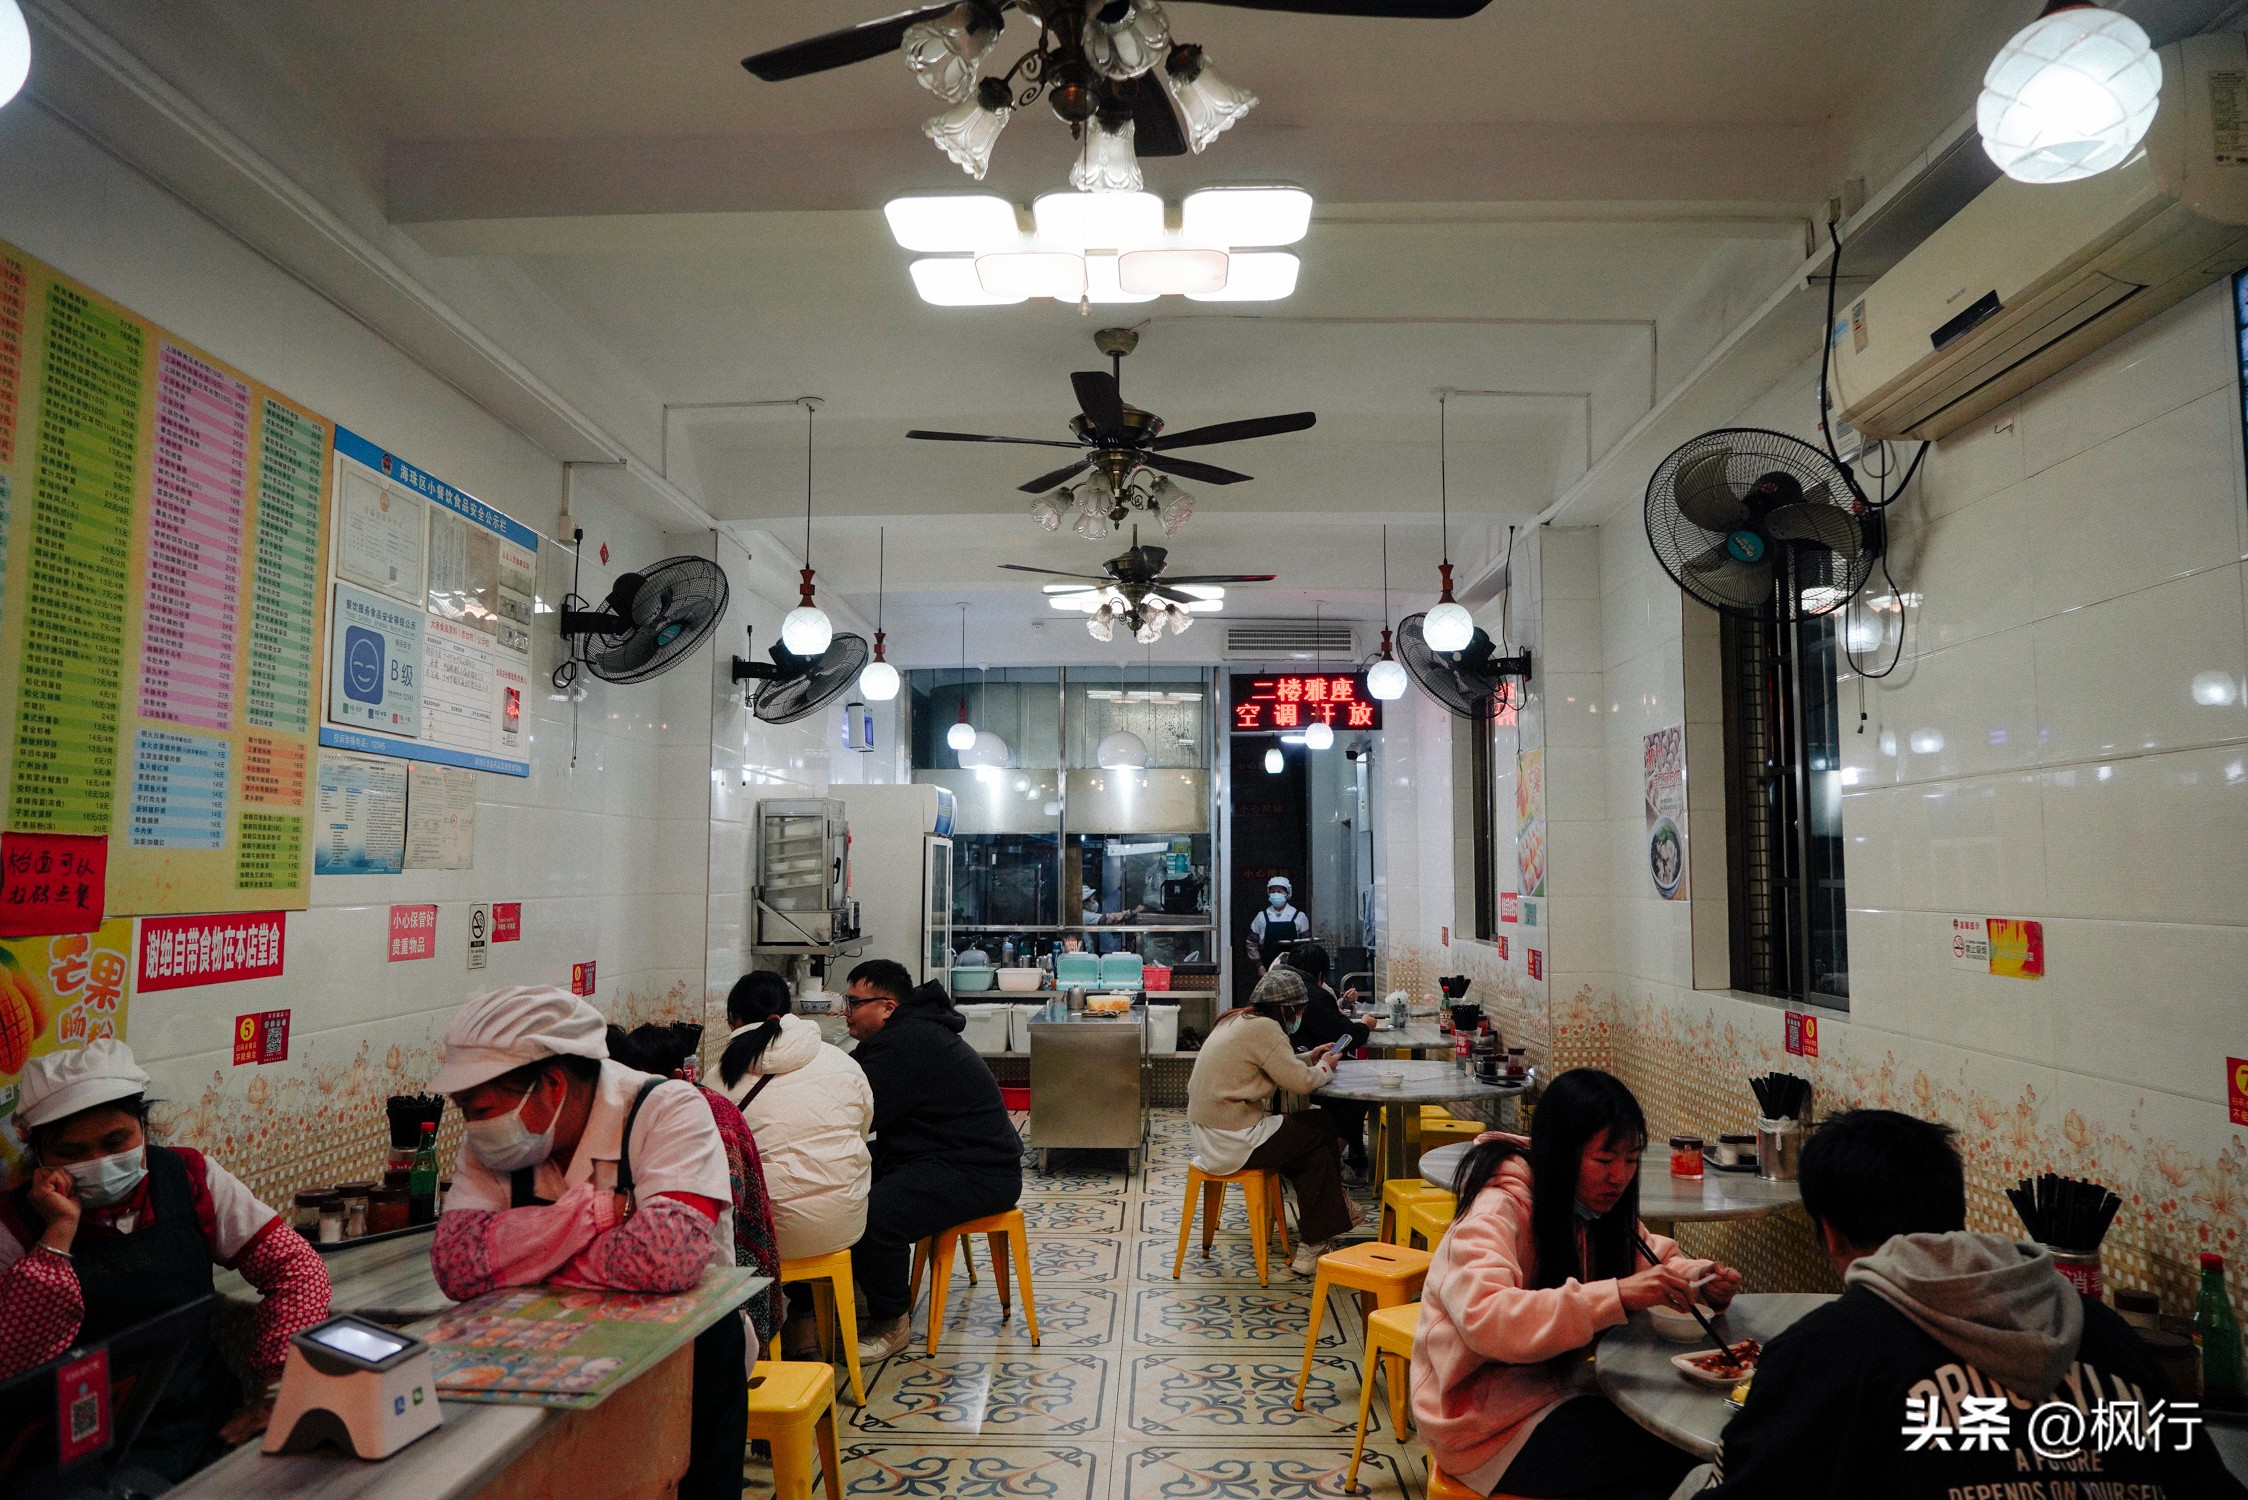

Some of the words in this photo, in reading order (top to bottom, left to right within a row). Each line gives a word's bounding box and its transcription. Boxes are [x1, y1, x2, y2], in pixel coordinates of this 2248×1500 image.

[120, 429, 133, 440] 20元
[400, 464, 507, 533] 海珠区小餐饮食品安全公示栏
[115, 515, 128, 526] 19元
[114, 526, 127, 536] 11元
[114, 537, 126, 547] 13元
[102, 544, 126, 558] 14元/2只
[100, 555, 125, 569] 20元/2只
[100, 577, 123, 590] 13元/4件
[97, 610, 121, 623] 13元/4件
[346, 599, 416, 630] 餐饮服务食品安全等级公示
[100, 622, 120, 634] 7元/2件
[95, 644, 119, 656] 13元/4件
[98, 656, 118, 666] 7元/2件
[391, 659, 413, 688] B级
[99, 690, 116, 699] 4元/只
[1251, 678, 1354, 702] 二楼雅座
[101, 713, 115, 722] 24元
[88, 744, 112, 755] 13元/4件
[18, 758, 48, 769] 广州油条
[94, 757, 112, 766] 6元/只
[214, 760, 224, 768] 14元
[95, 802, 109, 810] 19元
[93, 825, 107, 833] 20元
[134, 826, 152, 834] 牛肉粥
[393, 910, 434, 930] 小心保管好
[146, 922, 280, 980] 谢绝自带食物在本店堂食
[392, 937, 426, 956] 贵重物品
[51, 933, 126, 1010] 芒果
[244, 1022, 250, 1038] 5
[2016, 1450, 2030, 1472] A
[1948, 1482, 2046, 1500] DEPENDS
[2050, 1481, 2078, 1500] ON
